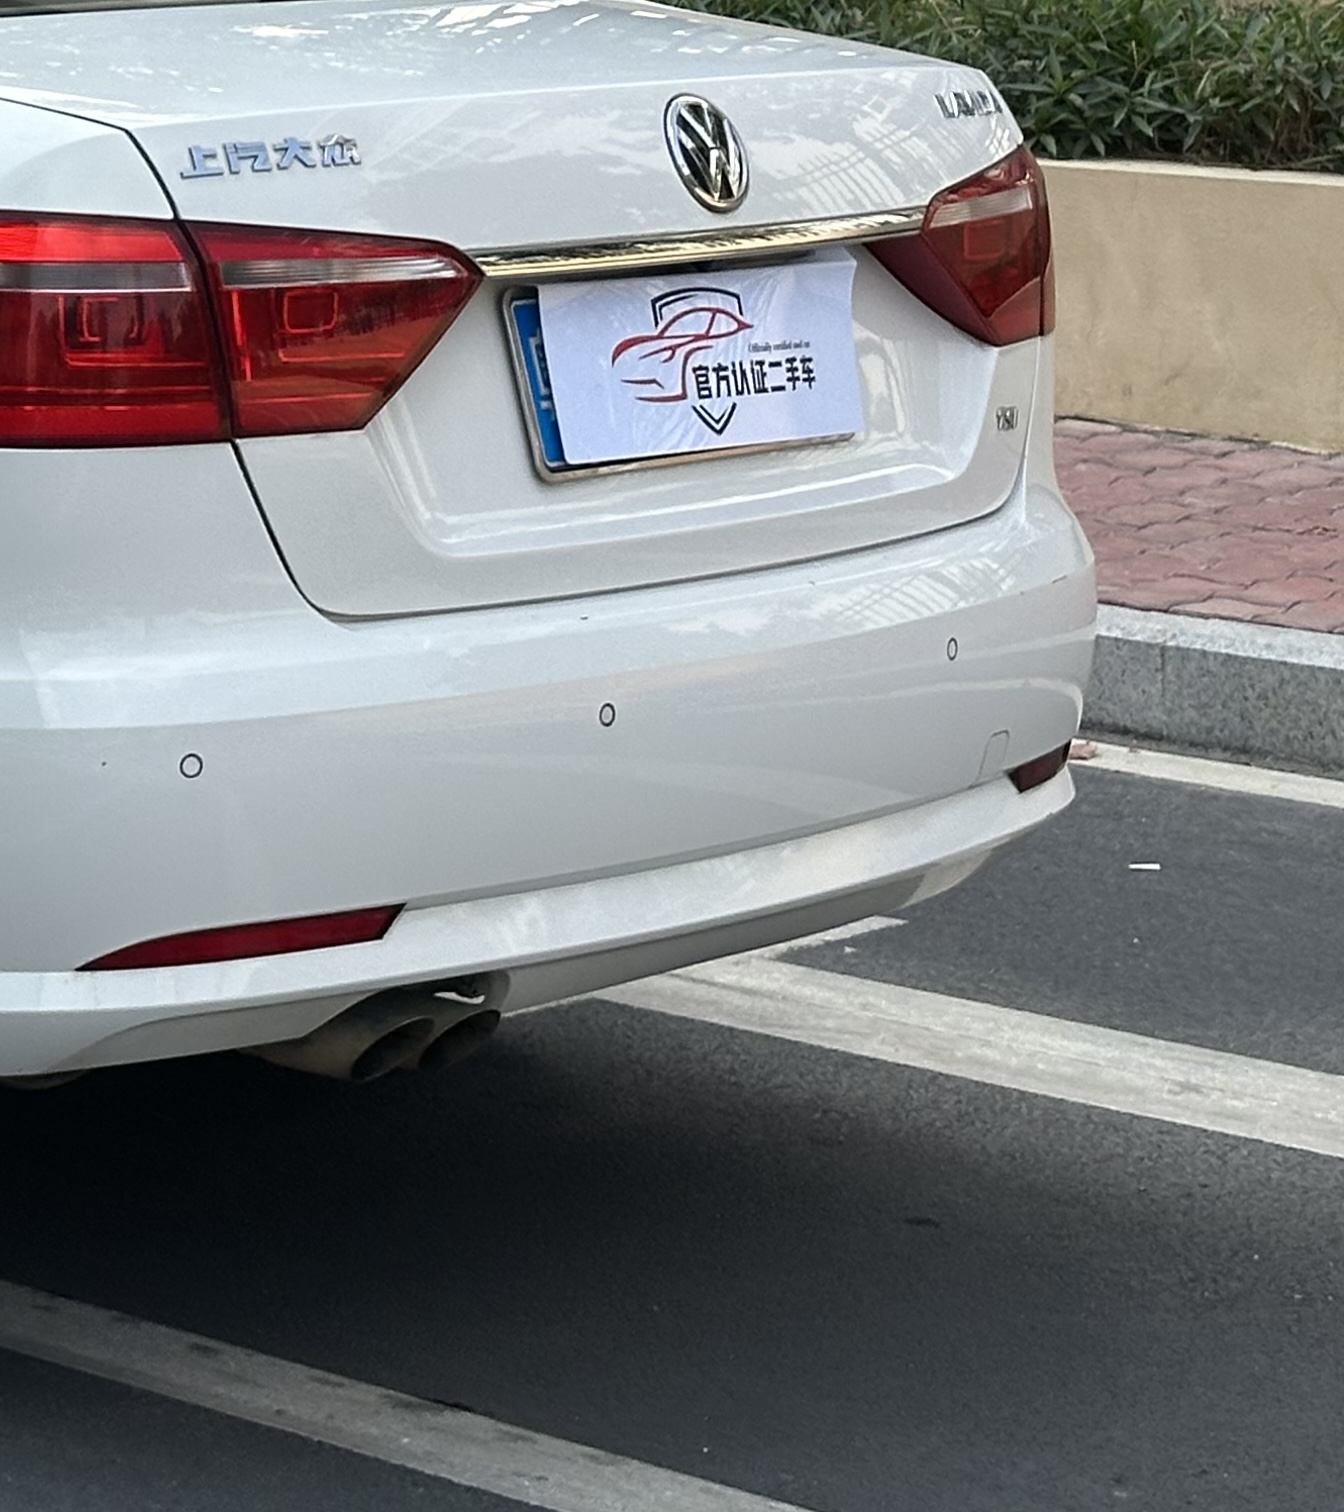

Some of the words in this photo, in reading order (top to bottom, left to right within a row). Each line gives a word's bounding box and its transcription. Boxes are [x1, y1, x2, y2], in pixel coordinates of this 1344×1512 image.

[180, 135, 361, 179] 上汽大众
[692, 356, 816, 400] 官方认证二手车
